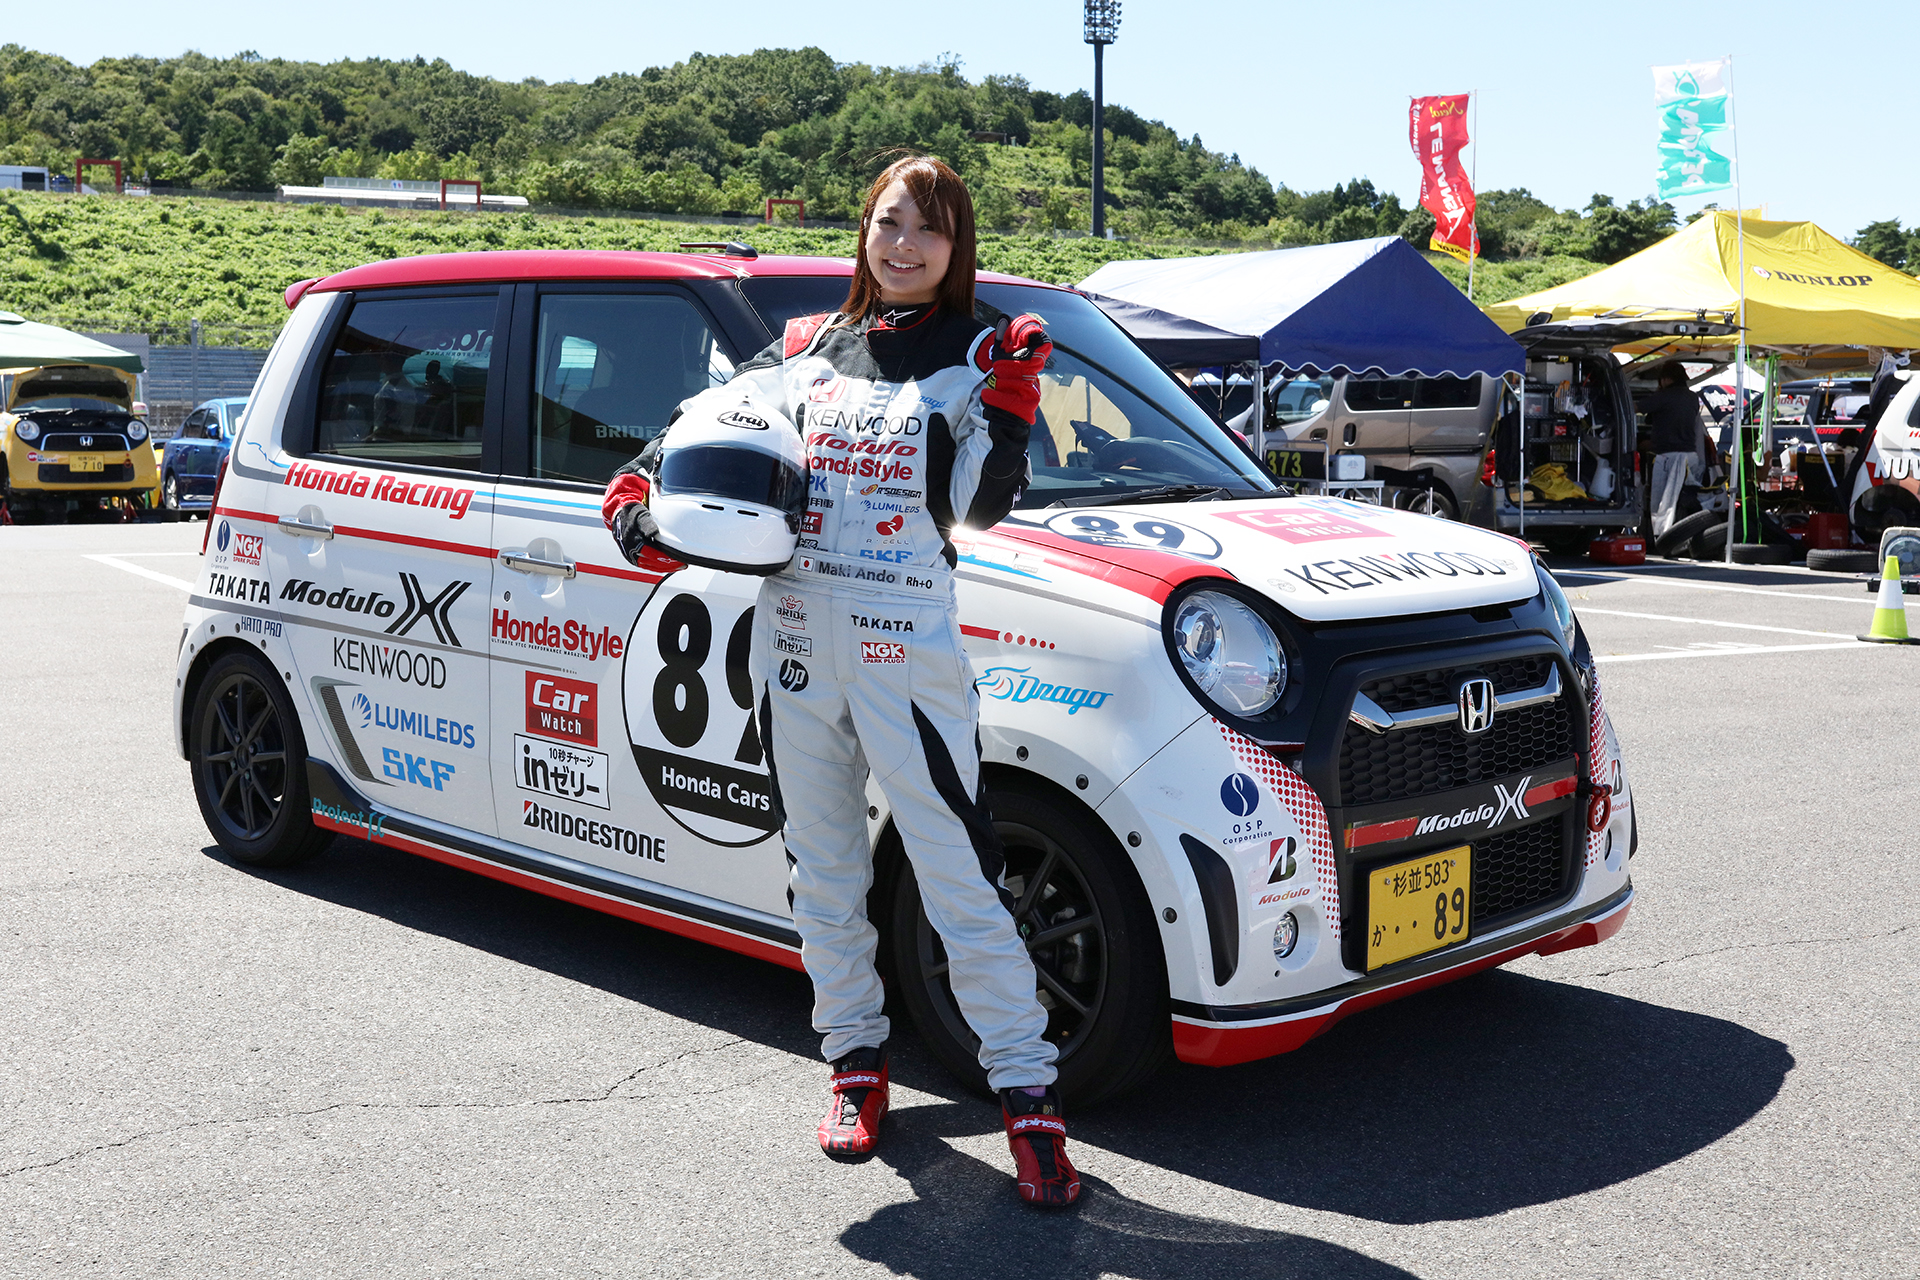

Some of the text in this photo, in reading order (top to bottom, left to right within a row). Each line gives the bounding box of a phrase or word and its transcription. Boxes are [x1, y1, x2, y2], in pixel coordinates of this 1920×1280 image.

[1773, 270, 1873, 286] DUNLOP
[724, 412, 764, 427] Arai
[808, 409, 922, 436] KENWOOD
[595, 425, 660, 438] BRIDE
[807, 432, 918, 456] Modulo
[1267, 450, 1302, 478] 373
[283, 462, 475, 520] Honda Racing
[872, 502, 920, 513] LUMILEDS
[804, 516, 819, 524] ar
[1237, 512, 1328, 528] Car
[1286, 524, 1363, 537] Watch
[1071, 515, 1185, 549] 89
[234, 535, 263, 559] NGK
[860, 549, 913, 564] SKF
[818, 561, 851, 577] Maki
[855, 568, 896, 584] Ando
[1283, 552, 1507, 595] KENWOOD
[209, 572, 270, 604] TAKATA
[279, 578, 395, 617] Modulo
[776, 606, 807, 622] BRIDE
[851, 614, 914, 632] TAKATA
[241, 616, 282, 638] KATO PRO
[491, 638, 513, 646] ULTIMATE
[528, 644, 562, 655] PERFORMANCE
[777, 633, 808, 653] inゼリー
[862, 643, 905, 657] NGK
[334, 637, 446, 689] KENWOOD
[532, 679, 589, 714] Car
[1011, 675, 1114, 715] Drago
[375, 703, 475, 749] LUMILEDS
[540, 712, 581, 735] Watch
[549, 747, 594, 767] 10秒チャージ
[382, 747, 455, 792] SKF
[523, 744, 600, 797] inゼリー
[662, 765, 770, 811] Honda Cars
[524, 800, 665, 863] BRIDGESTONE
[1415, 804, 1494, 836] Modulo
[1223, 830, 1273, 845] Corporation
[1258, 887, 1310, 905] Modulo
[1434, 887, 1464, 940] 89
